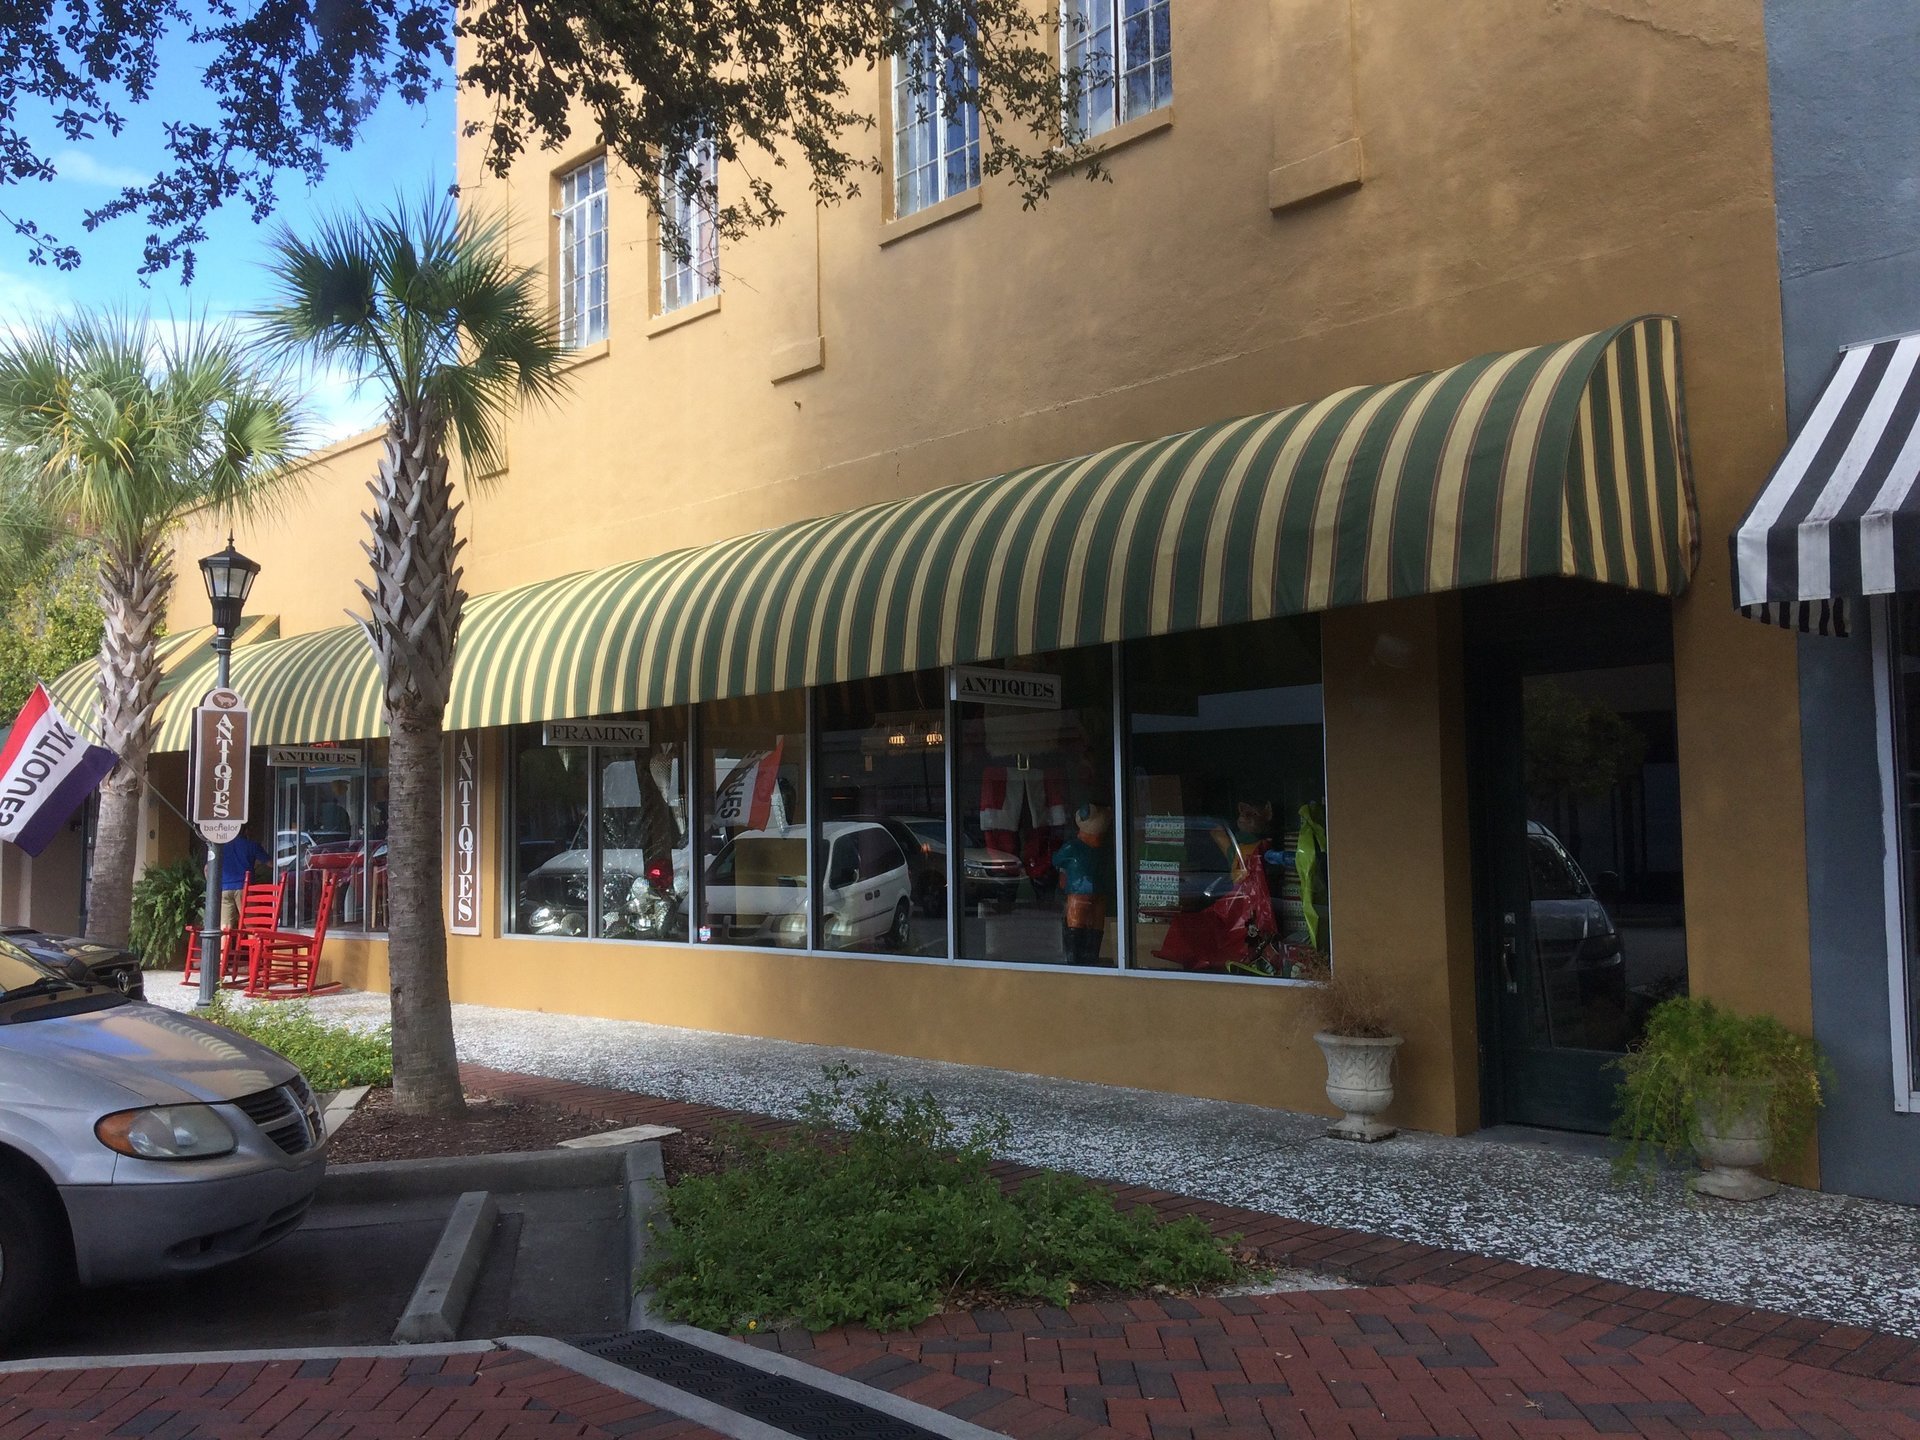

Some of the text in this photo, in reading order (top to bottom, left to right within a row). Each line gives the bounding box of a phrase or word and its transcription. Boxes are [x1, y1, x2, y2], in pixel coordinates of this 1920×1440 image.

[961, 676, 1055, 698] ANTIQUES
[552, 725, 644, 741] FRAMING
[213, 713, 235, 819] ANTIQUES
[275, 751, 357, 763] ANTIQUES
[203, 823, 239, 832] bachelor
[458, 735, 474, 921] ANTIQUES
